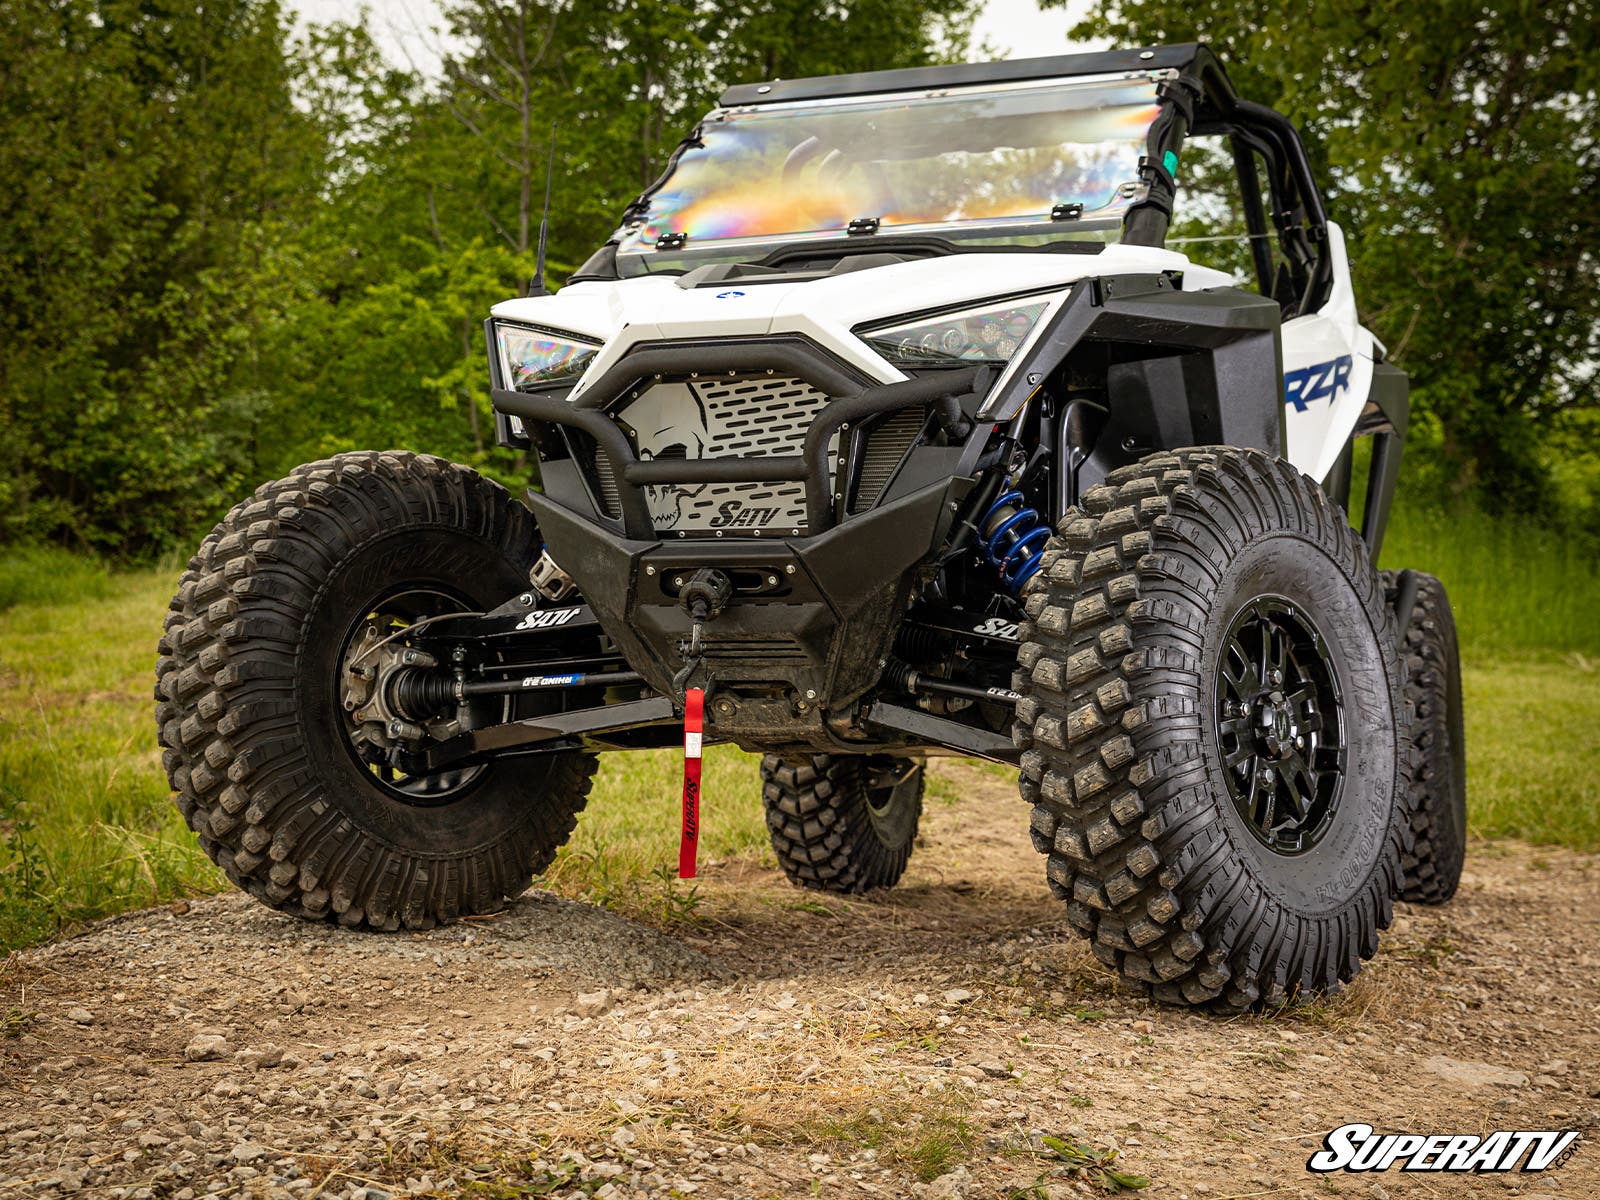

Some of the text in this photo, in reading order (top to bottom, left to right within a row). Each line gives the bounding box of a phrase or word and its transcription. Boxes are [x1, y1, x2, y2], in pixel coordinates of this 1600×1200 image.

[1284, 354, 1353, 413] RZR
[709, 500, 781, 527] SATV
[515, 607, 581, 630] SATV
[973, 617, 1020, 640] SA
[541, 676, 573, 686] RHINO
[685, 776, 699, 843] SUPERATV
